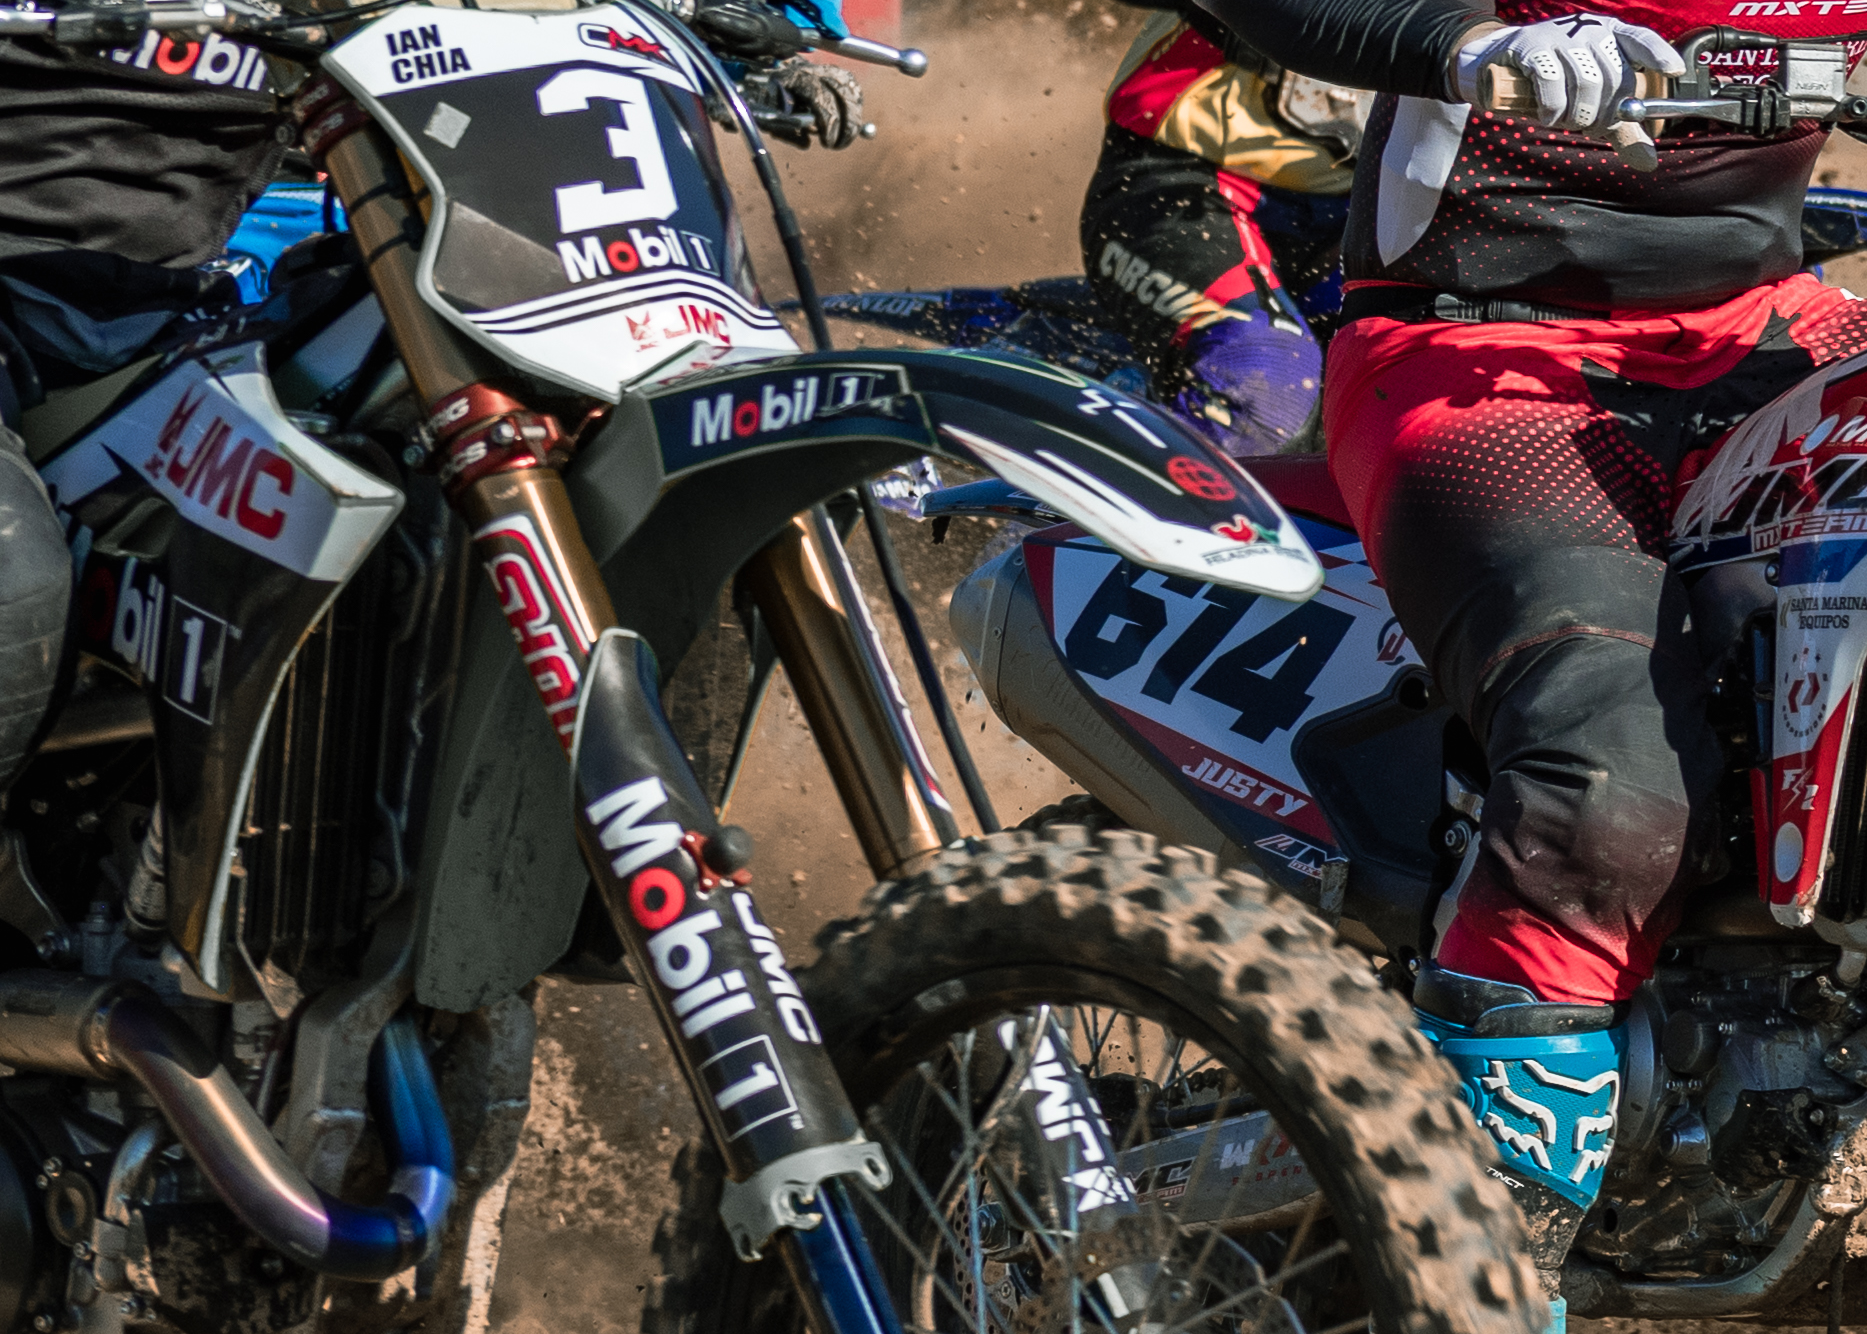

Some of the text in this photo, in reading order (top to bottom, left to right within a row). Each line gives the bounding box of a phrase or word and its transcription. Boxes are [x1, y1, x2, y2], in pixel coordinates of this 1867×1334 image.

[385, 23, 443, 57] IAN
[390, 47, 473, 85] CHIA
[535, 67, 680, 235] 3
[556, 224, 690, 284] Mobil
[690, 375, 823, 449] Mobil
[166, 415, 297, 543] JMC
[1789, 596, 1820, 612] SANTA
[1796, 614, 1851, 631] EQUIPOS
[1064, 560, 1358, 745] 614
[1182, 756, 1308, 818] JUSTY
[585, 775, 756, 1041] Mobil
[731, 889, 823, 1046] JMC
